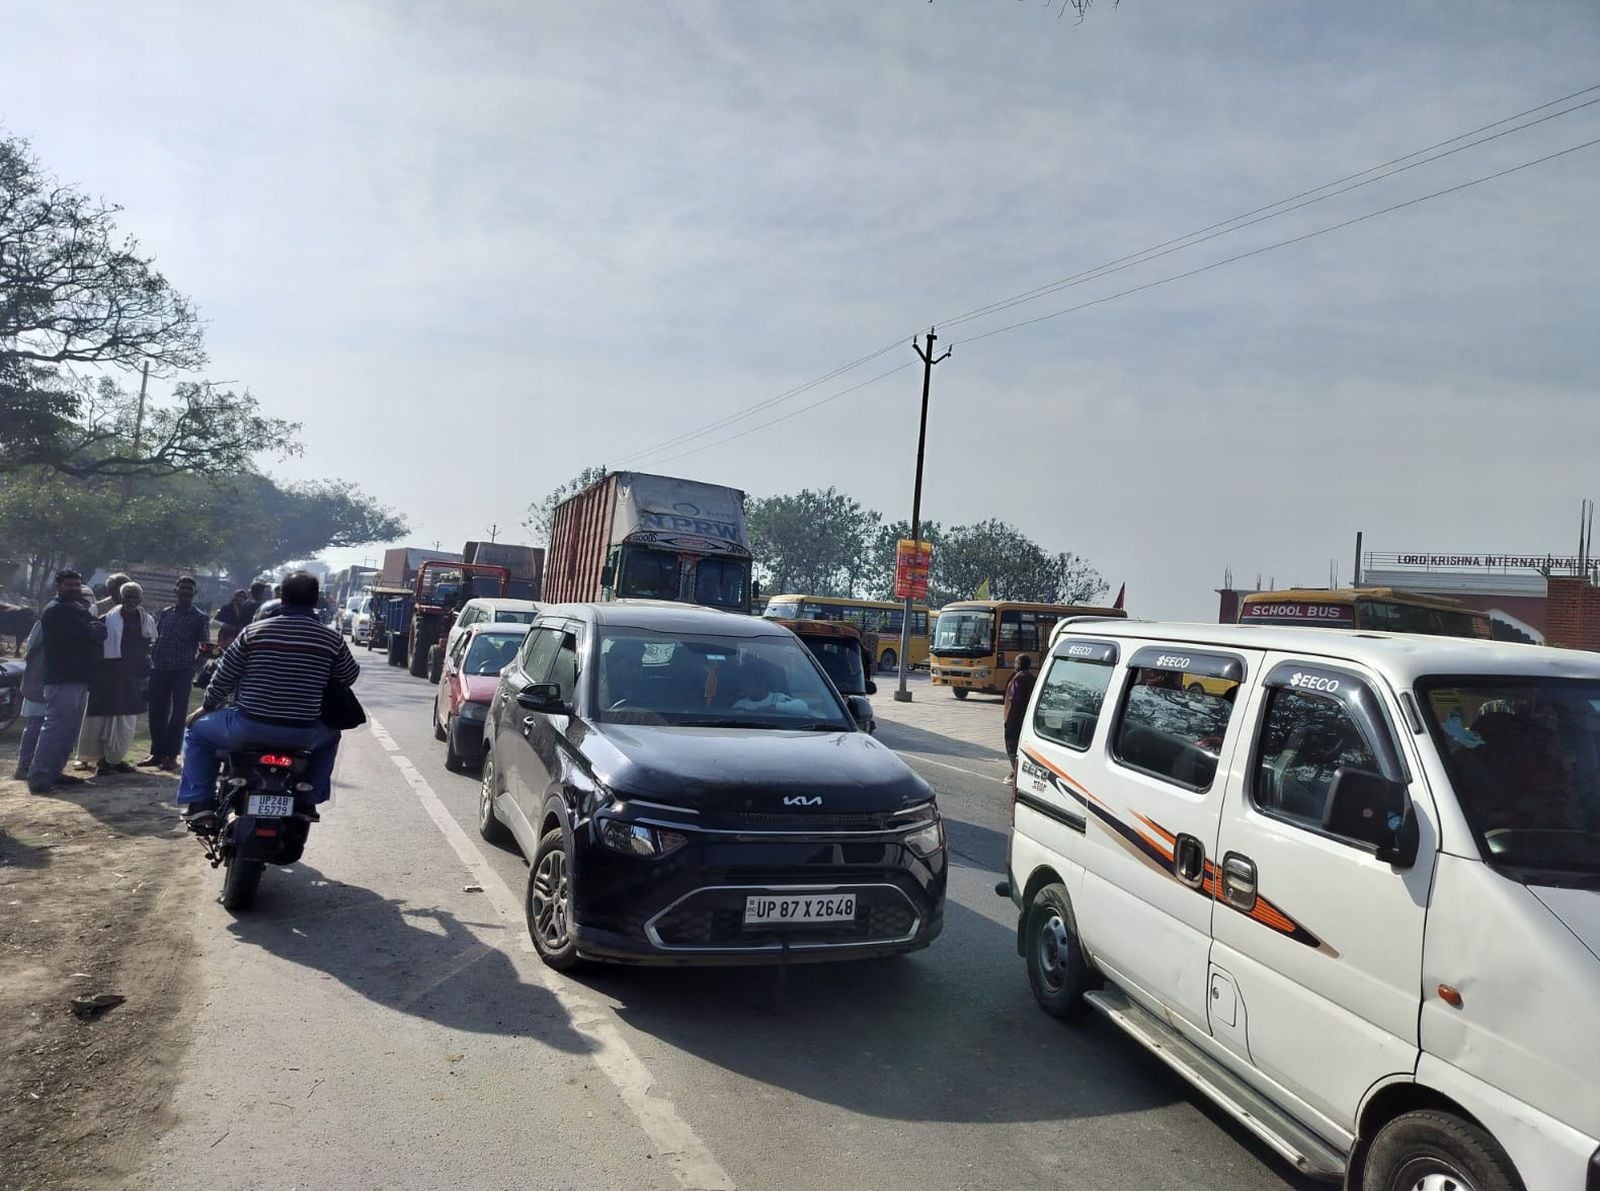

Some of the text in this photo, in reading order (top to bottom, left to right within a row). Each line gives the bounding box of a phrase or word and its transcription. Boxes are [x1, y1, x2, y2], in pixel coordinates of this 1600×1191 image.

[1397, 555, 1427, 565] LORD
[1430, 555, 1480, 567] KRISHNA
[1484, 556, 1581, 569] INTERNATIONAL
[1251, 605, 1341, 618] SCHOOL BUS
[258, 805, 288, 815] E5779
[756, 901, 776, 918] UP
[780, 901, 799, 918] 87
[803, 900, 813, 918] X
[815, 899, 854, 917] 2648
